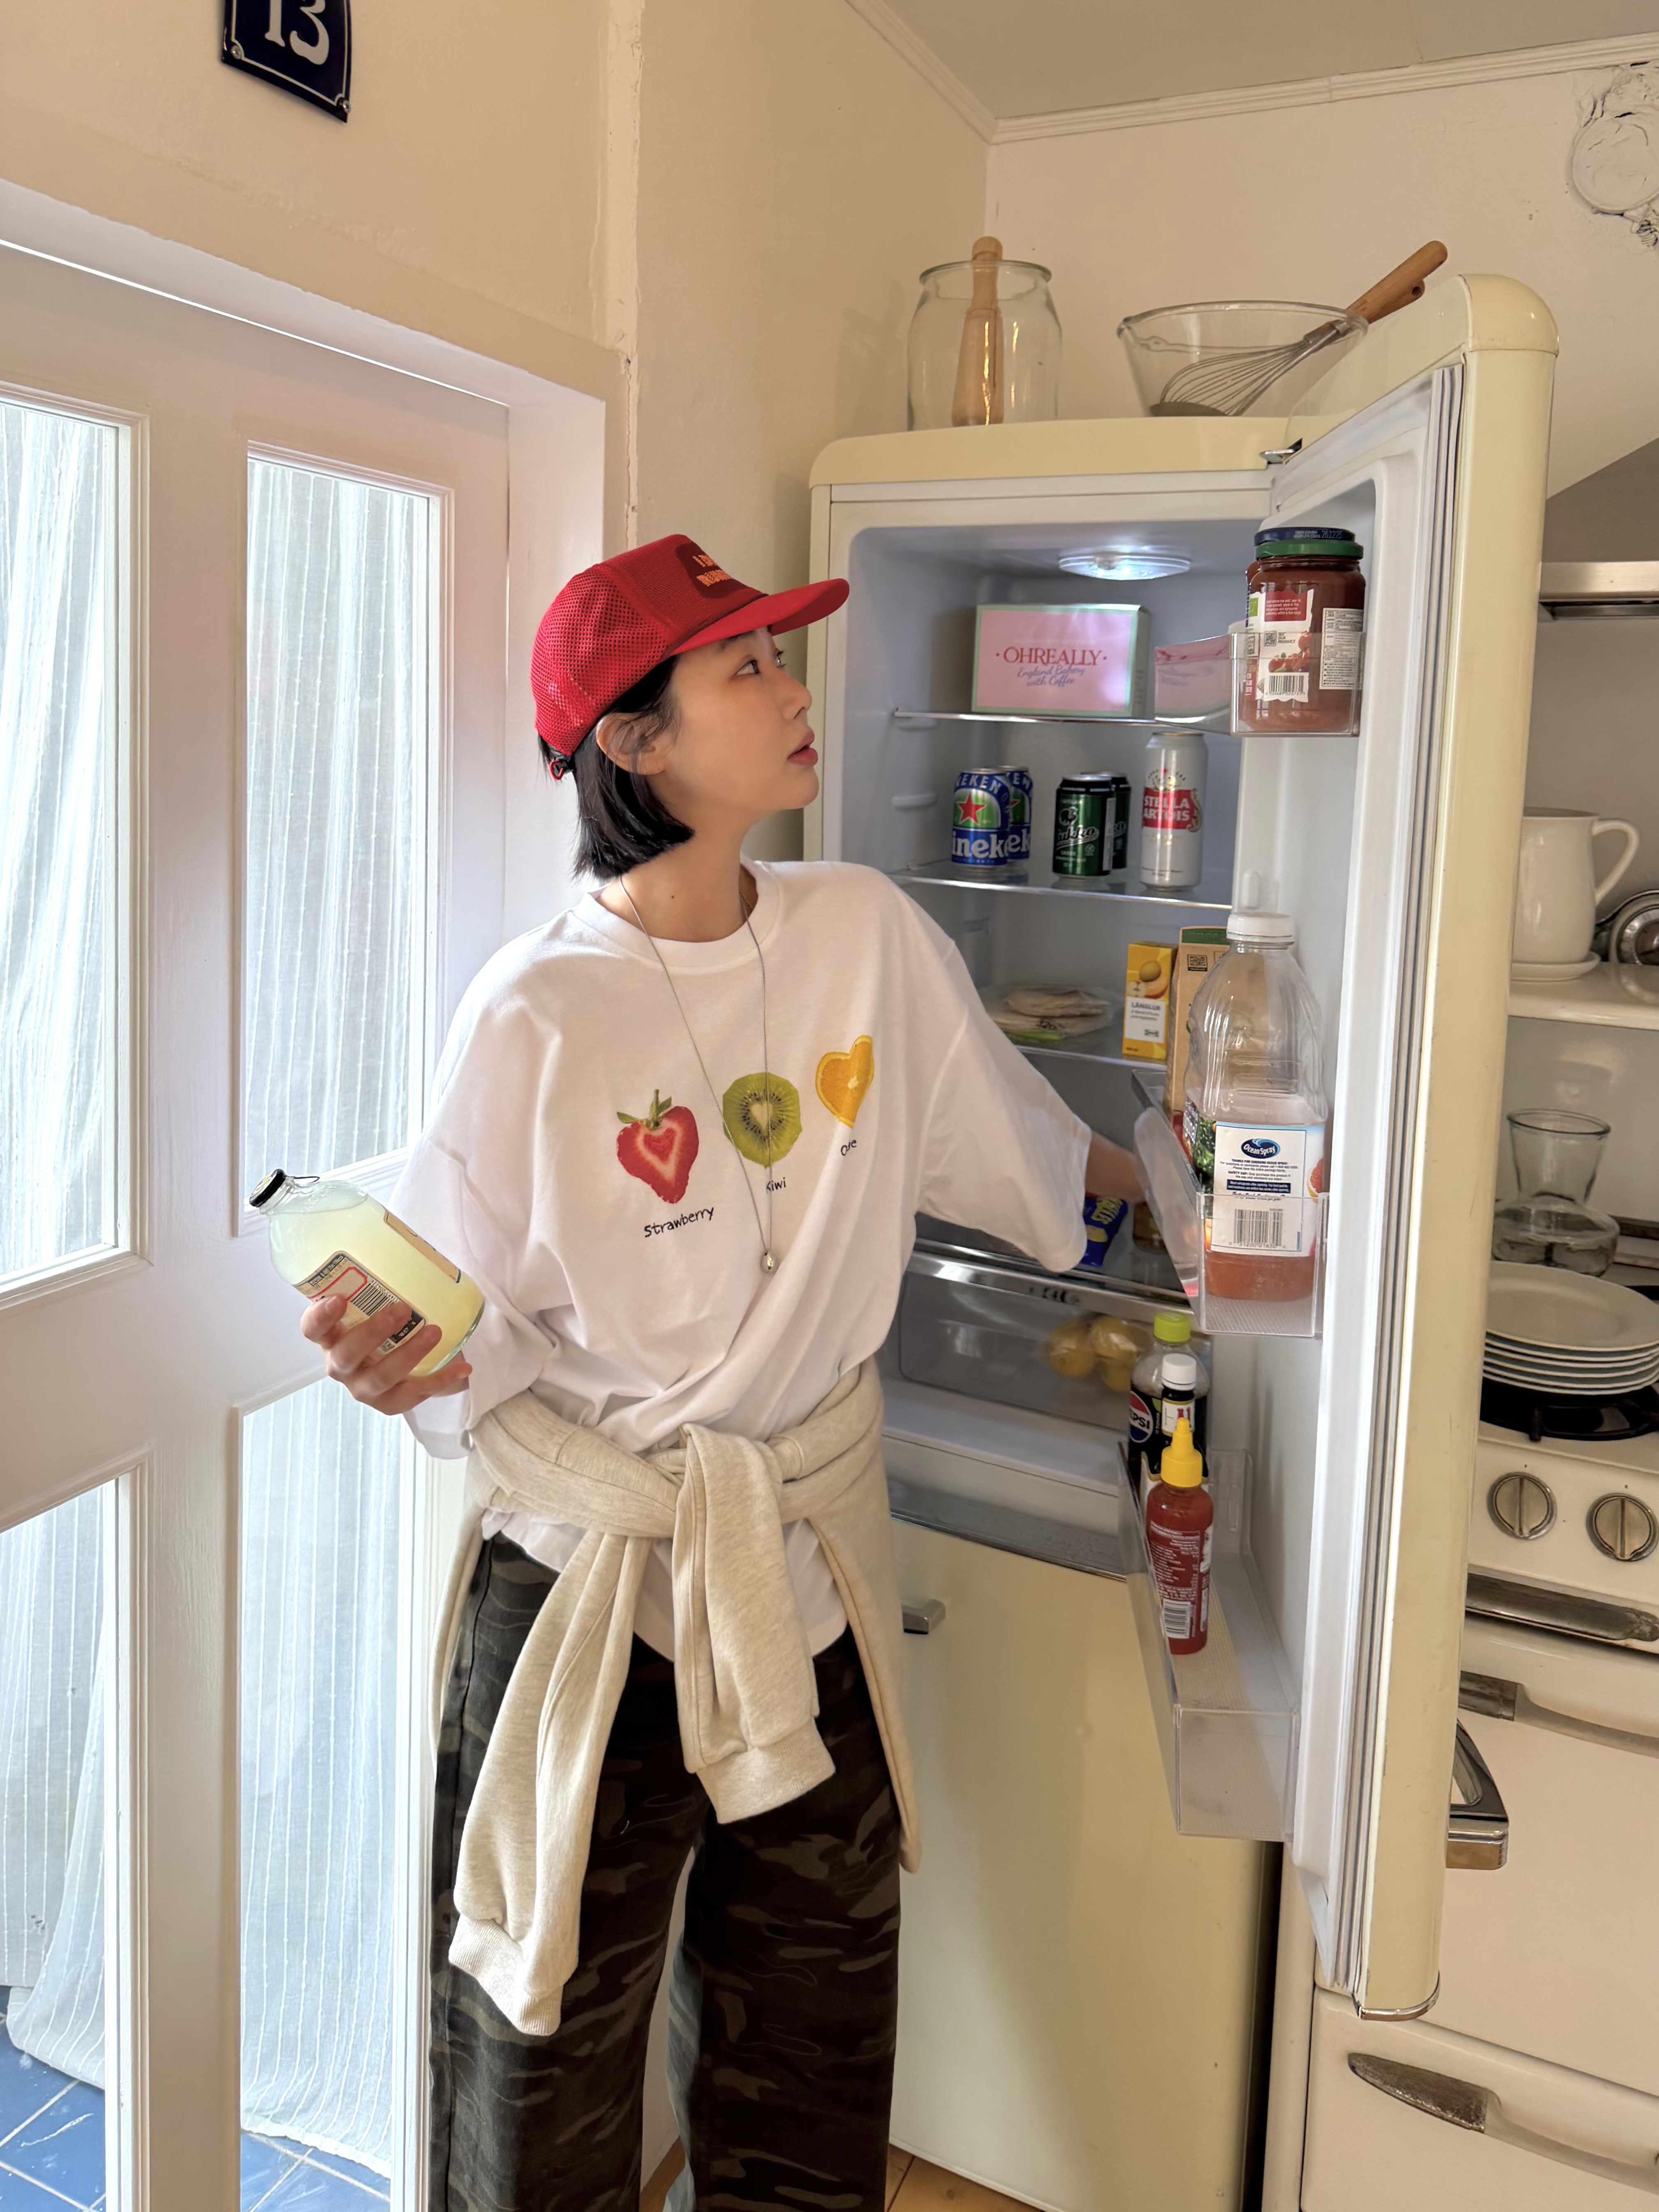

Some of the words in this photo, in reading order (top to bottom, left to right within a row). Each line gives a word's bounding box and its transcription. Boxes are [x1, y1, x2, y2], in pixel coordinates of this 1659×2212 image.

[1003, 646, 1102, 666] OHREALLY
[1144, 795, 1190, 809] STELLA
[1143, 807, 1190, 821] ARTOIS
[1243, 1144, 1260, 1155] Ocean
[1260, 1146, 1275, 1156] Spray
[644, 1207, 714, 1237] Strawberry
